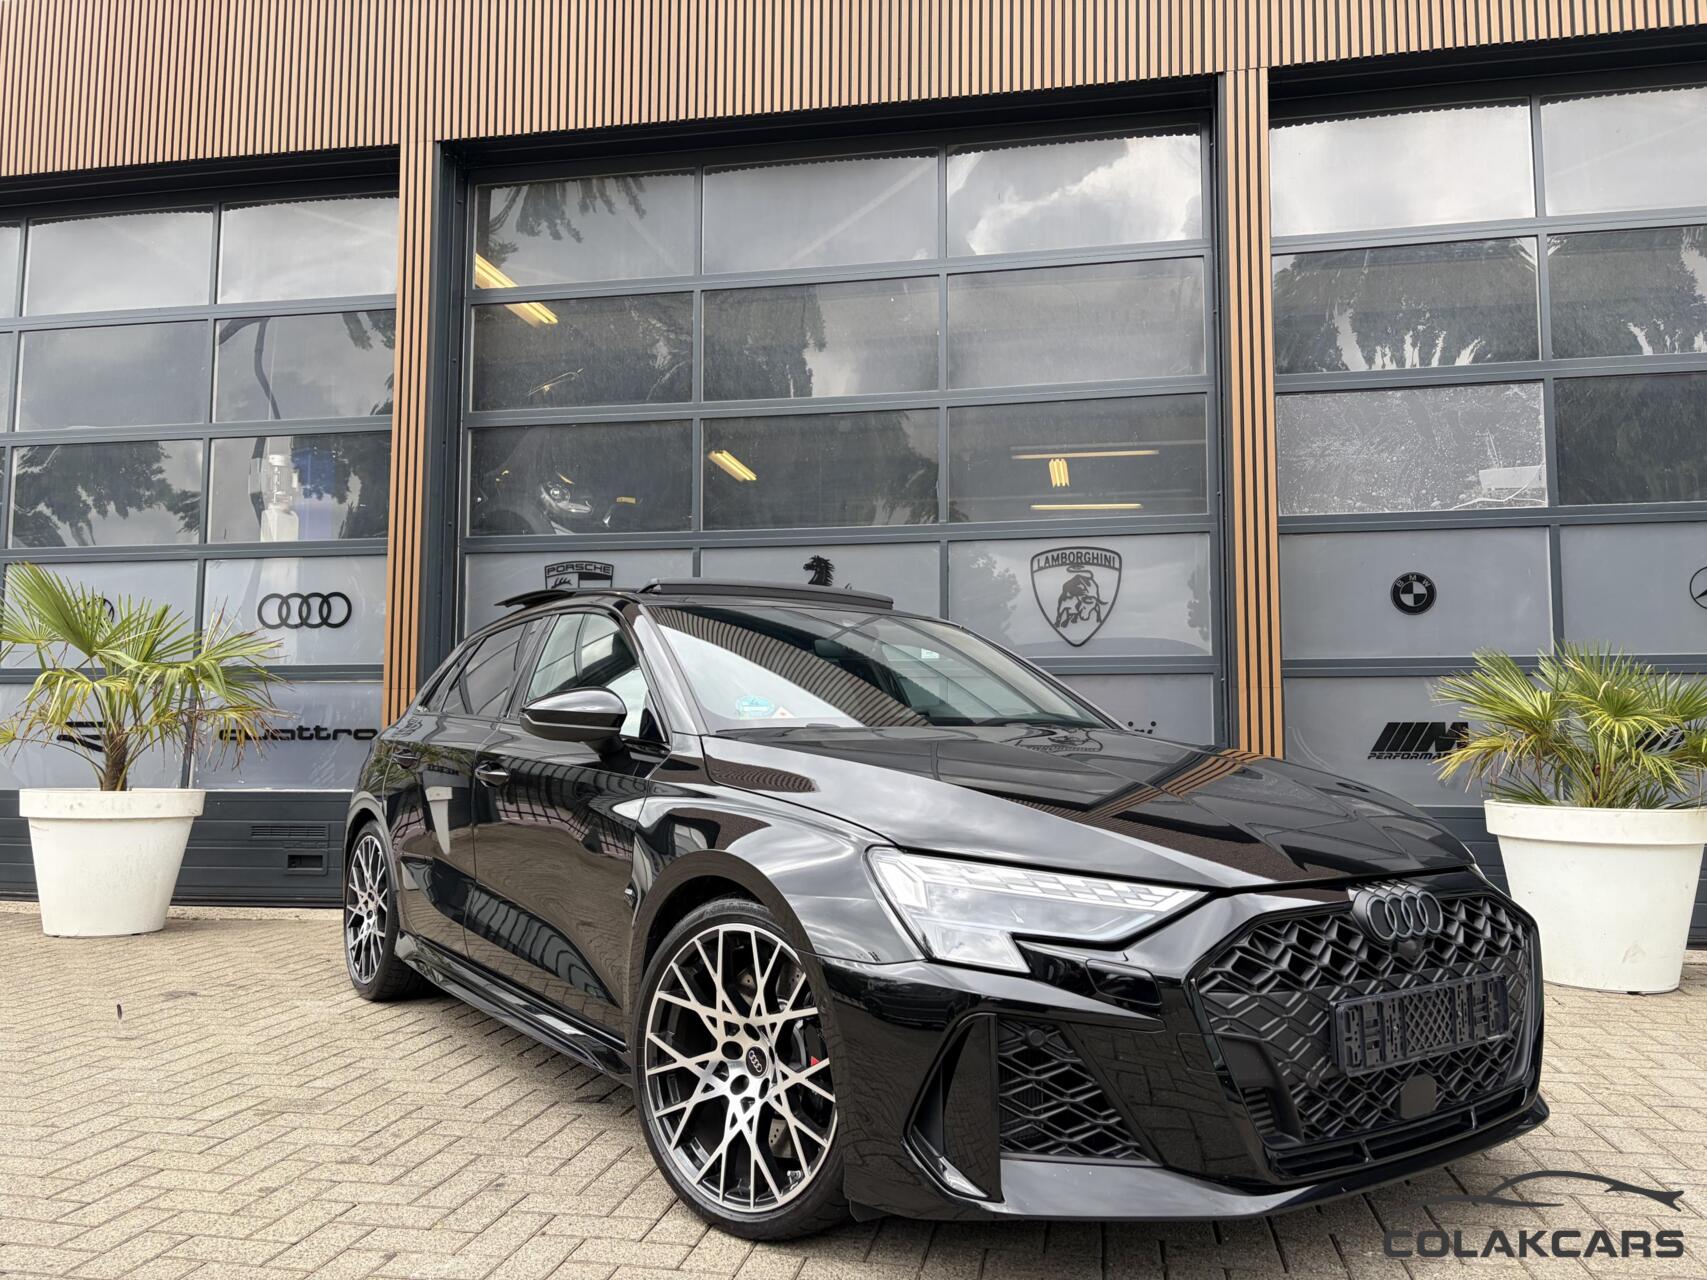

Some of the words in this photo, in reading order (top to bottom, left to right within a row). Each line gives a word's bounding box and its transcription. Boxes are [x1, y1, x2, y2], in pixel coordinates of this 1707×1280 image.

[1037, 551, 1115, 568] LAMBORGHINI
[547, 563, 611, 575] PORSCHE
[1395, 574, 1431, 587] BMW
